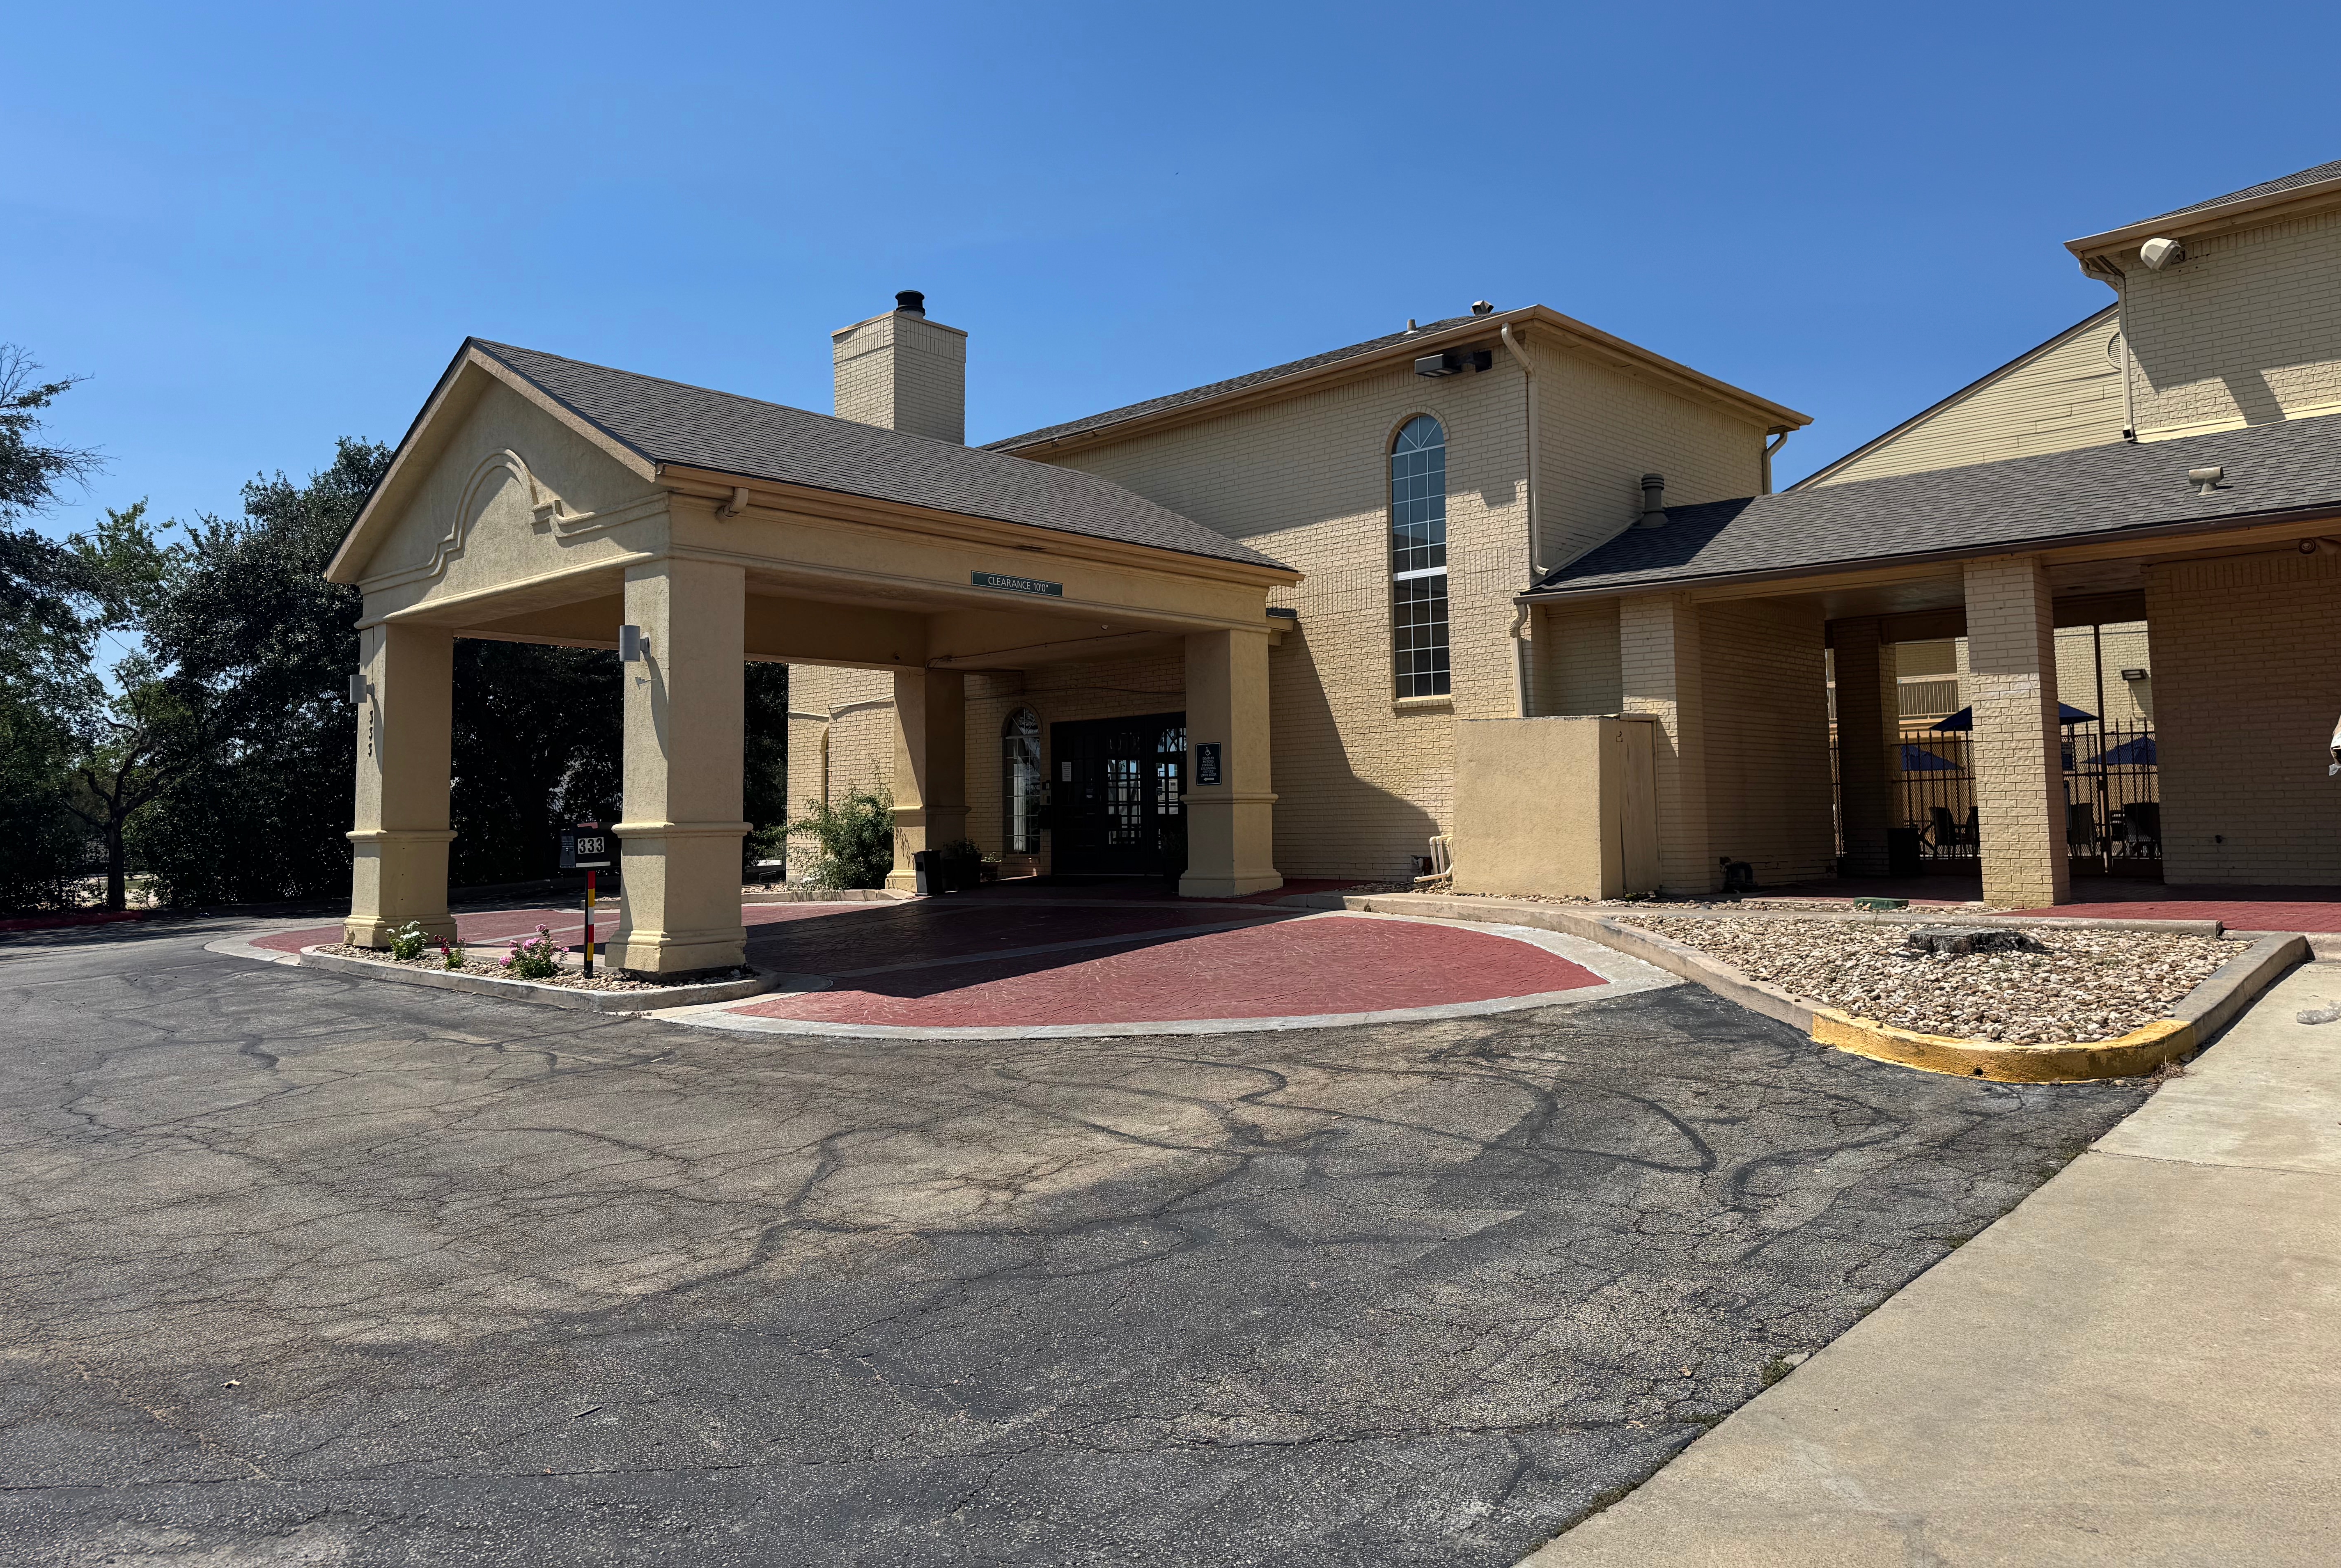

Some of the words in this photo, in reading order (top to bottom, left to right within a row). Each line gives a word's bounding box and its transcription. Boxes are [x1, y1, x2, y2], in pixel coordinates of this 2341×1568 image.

[988, 576, 1030, 590] CLEARANCE
[1033, 583, 1049, 592] 10'0"
[579, 838, 603, 853] 333
